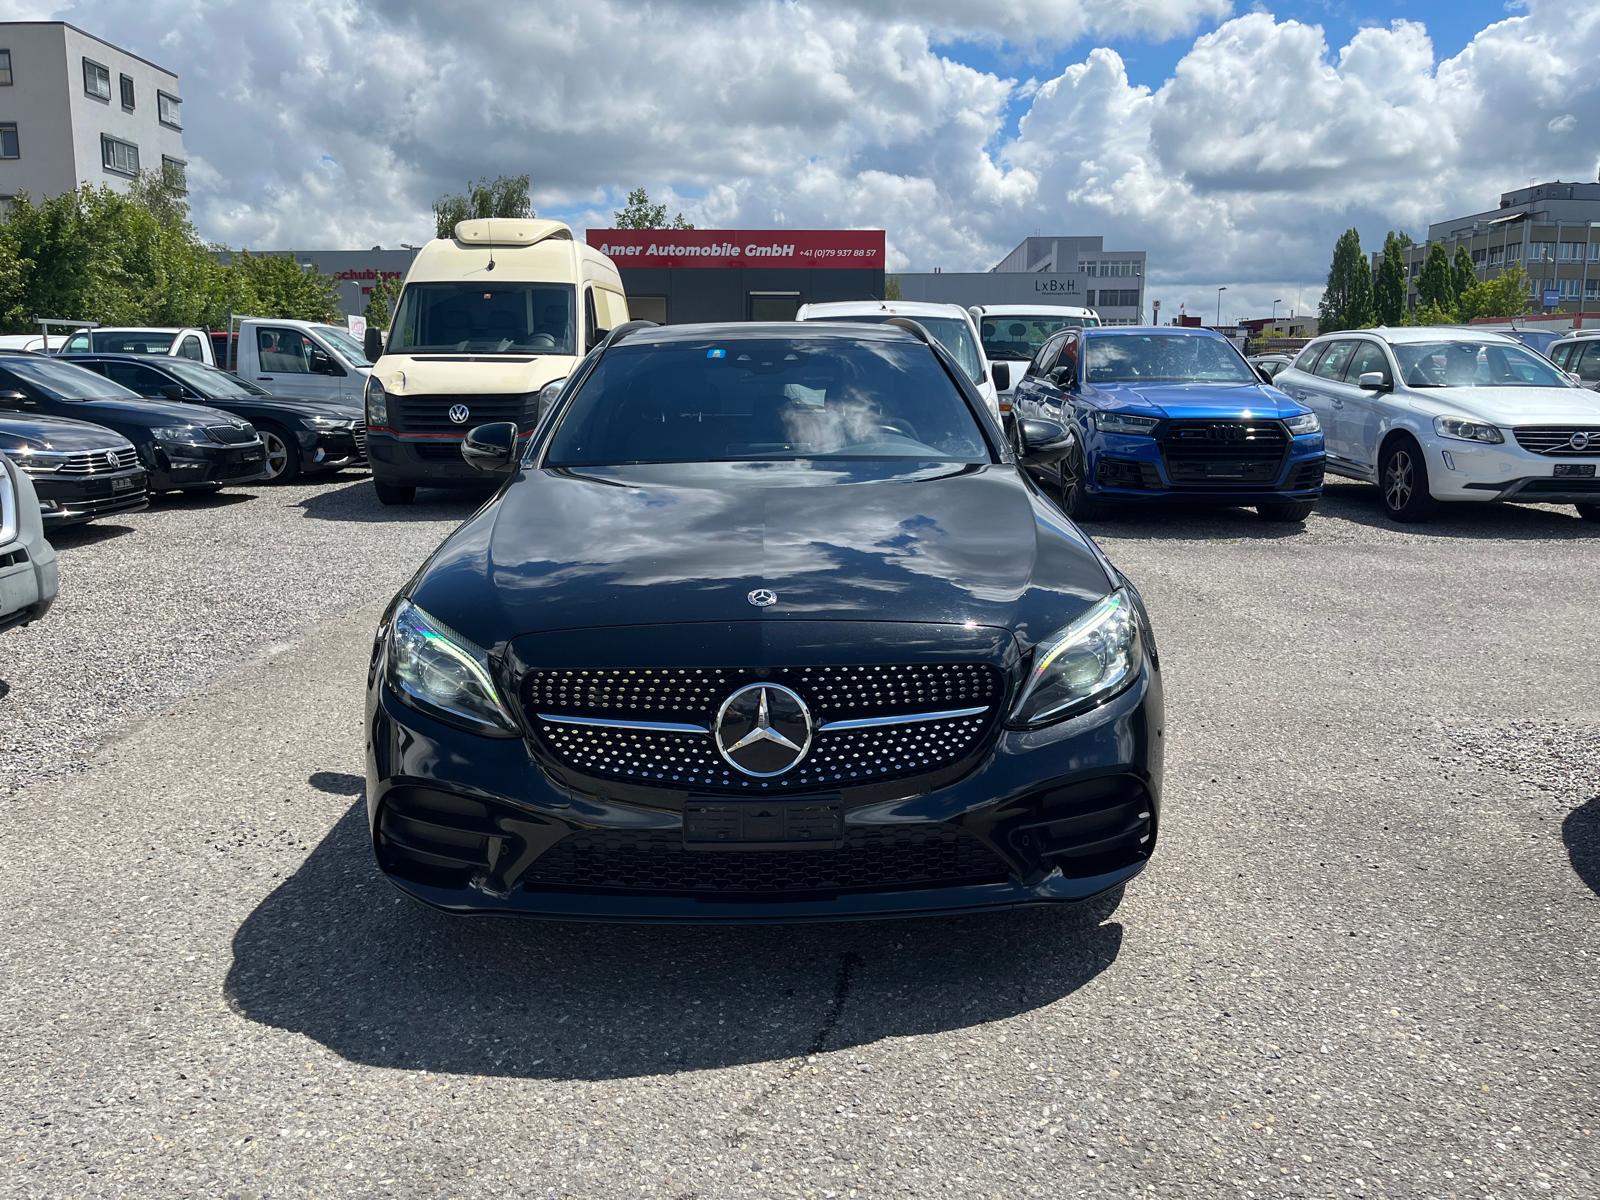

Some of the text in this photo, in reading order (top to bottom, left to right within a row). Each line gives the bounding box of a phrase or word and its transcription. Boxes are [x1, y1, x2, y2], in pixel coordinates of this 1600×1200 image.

[600, 242, 877, 258] Amer Automobile GmbH +41 (0)79 937 88 57
[1035, 279, 1075, 291] LxBxH
